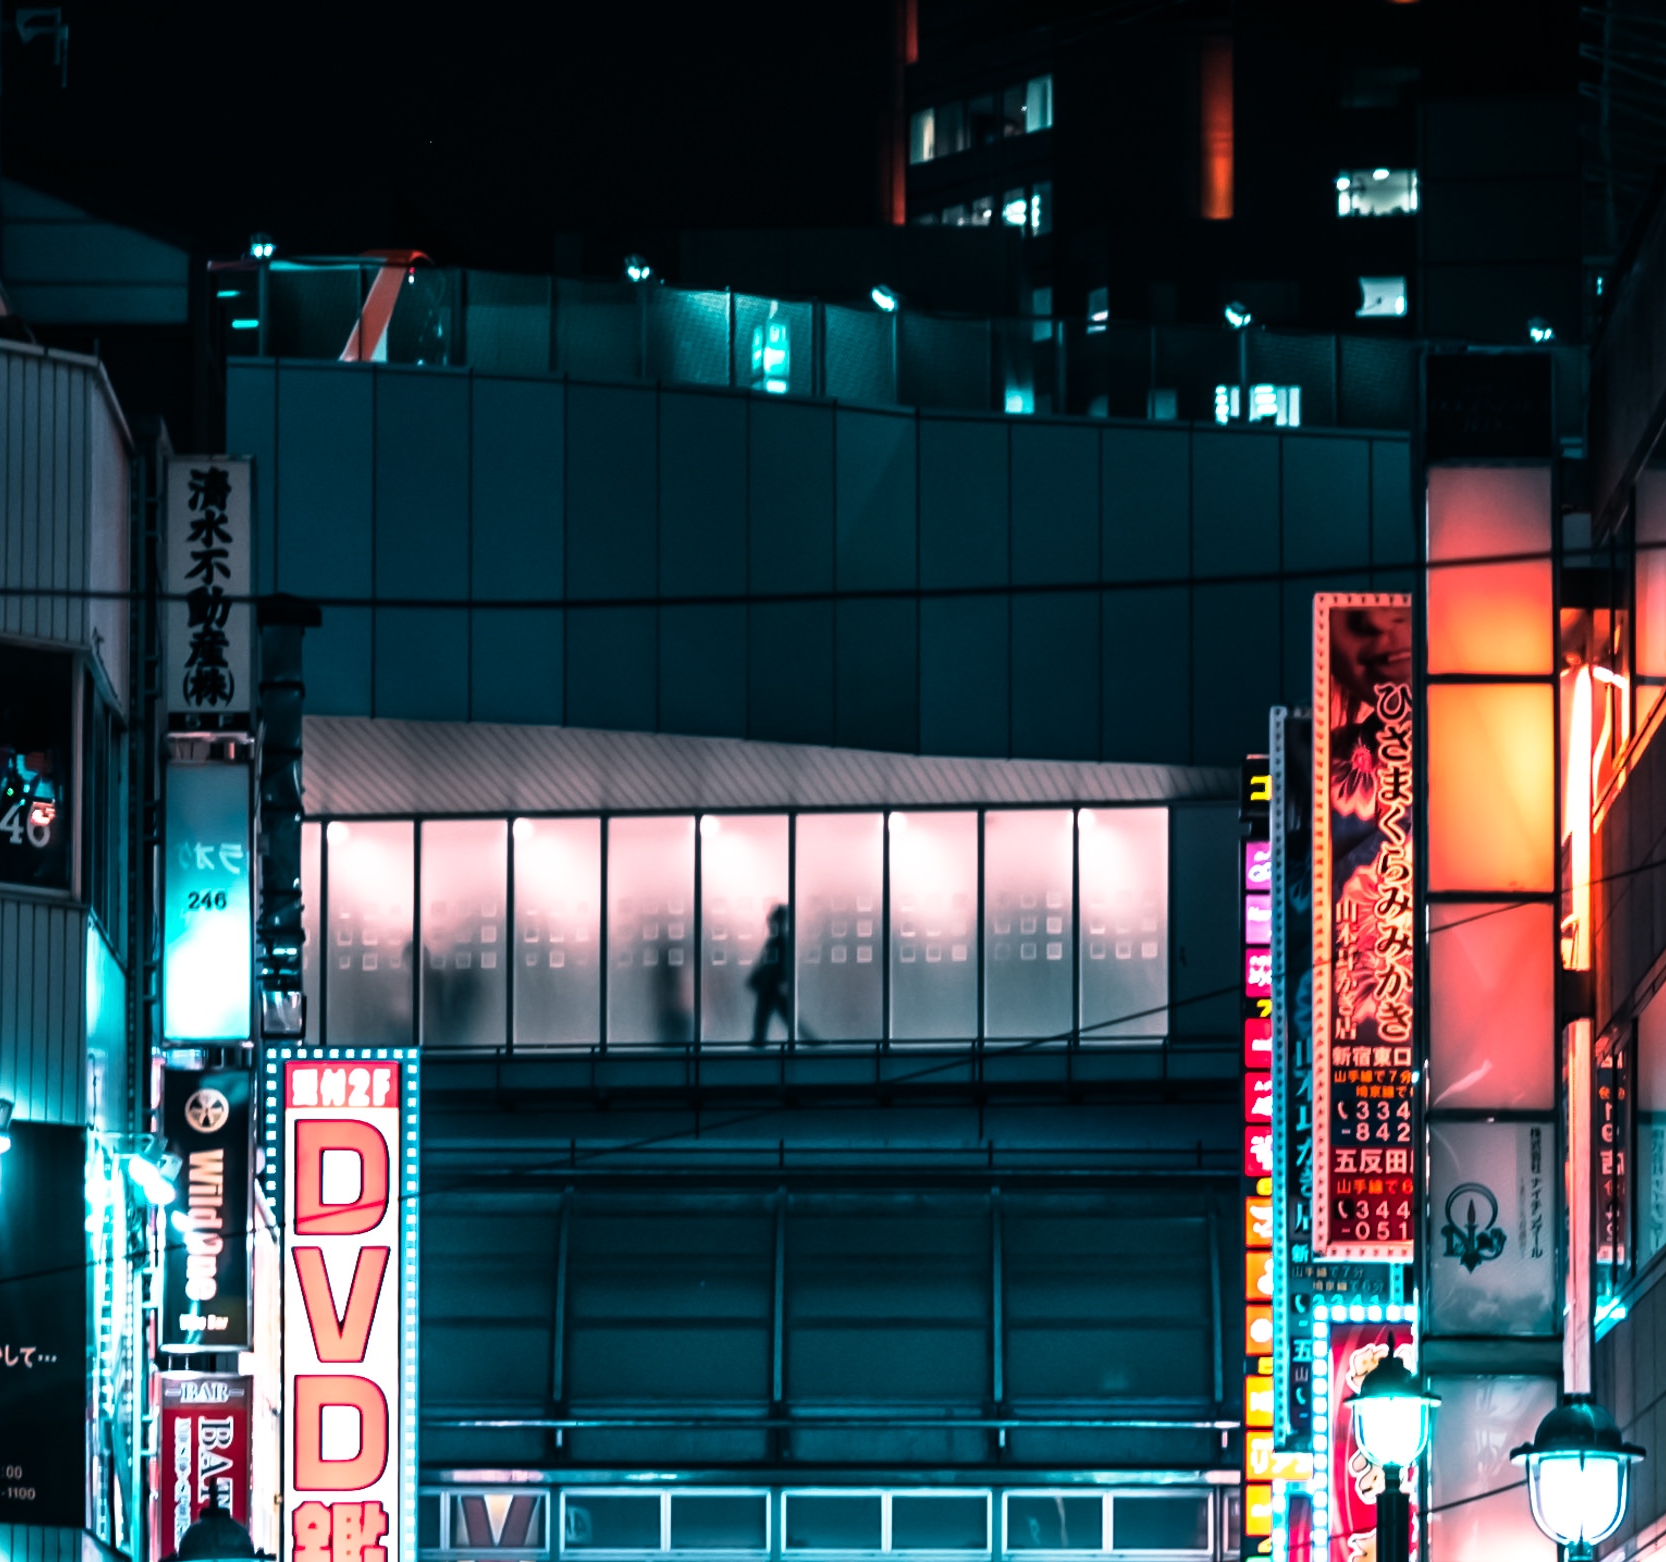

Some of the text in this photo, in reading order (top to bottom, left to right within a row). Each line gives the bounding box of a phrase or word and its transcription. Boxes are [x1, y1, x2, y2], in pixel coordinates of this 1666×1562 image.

[1376, 681, 1413, 1043] ひさまくらみみかき
[188, 891, 227, 910] 246
[1333, 1149, 1413, 1174] 五反田
[179, 1381, 230, 1403] BAR
